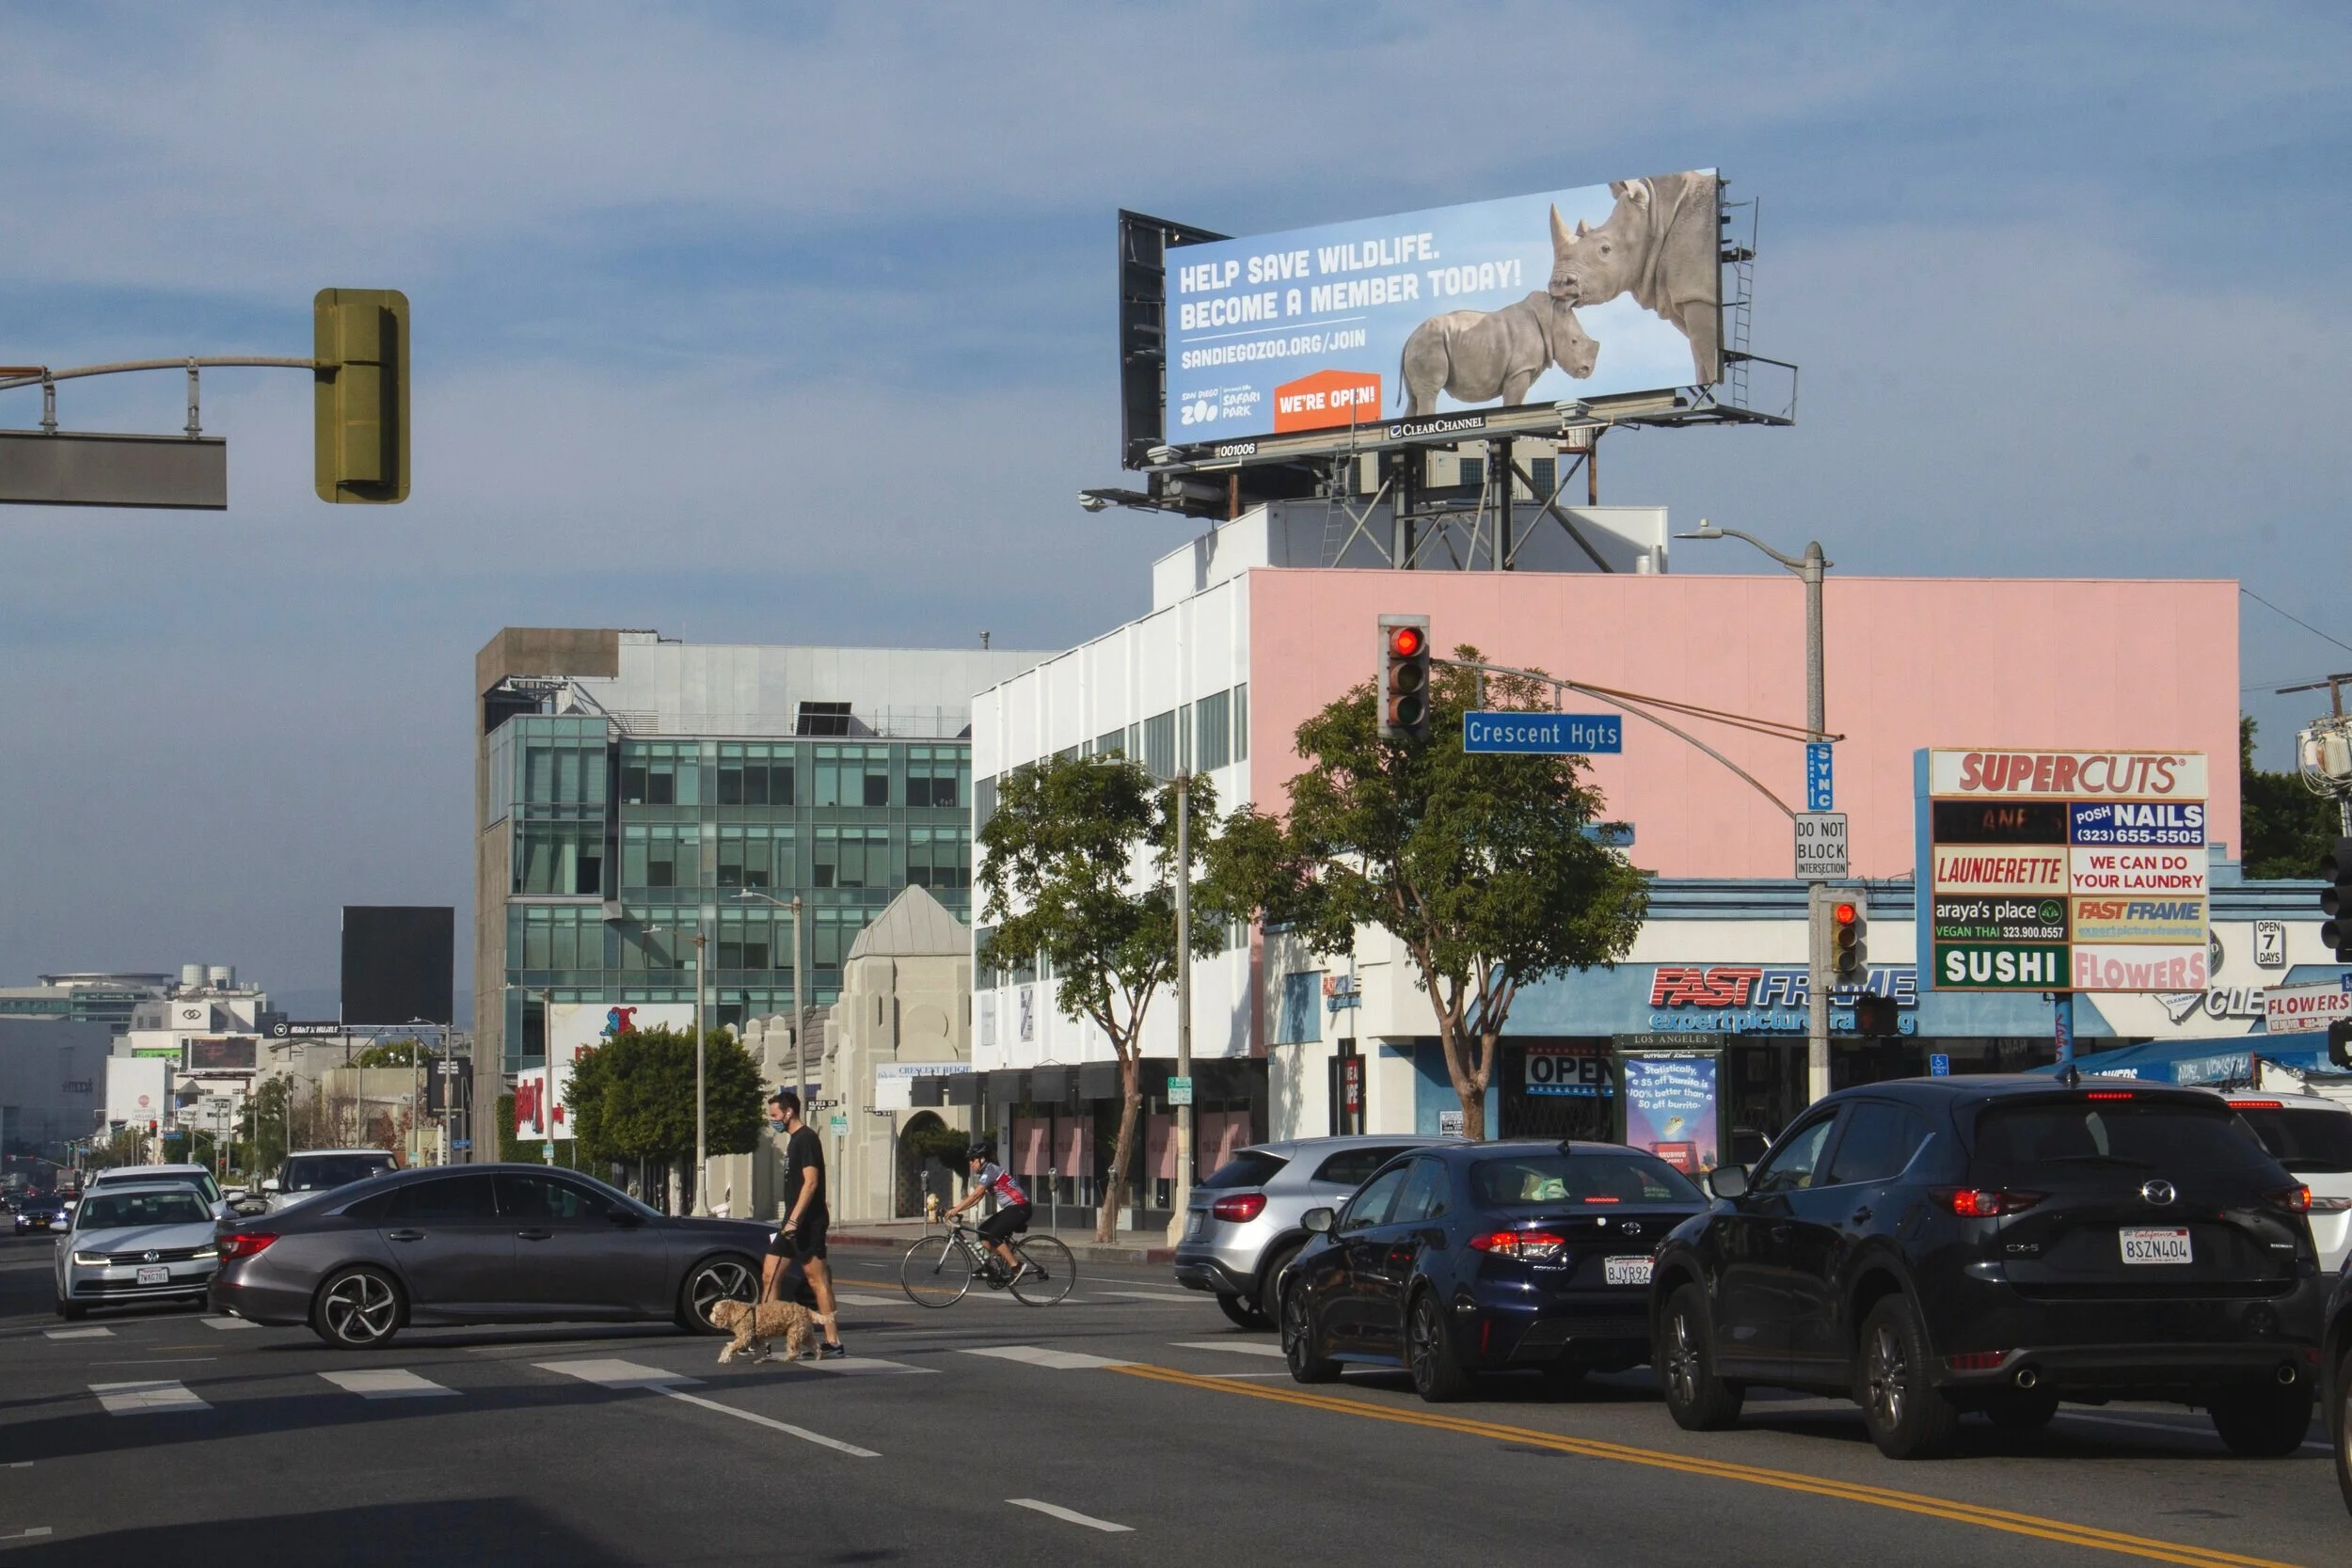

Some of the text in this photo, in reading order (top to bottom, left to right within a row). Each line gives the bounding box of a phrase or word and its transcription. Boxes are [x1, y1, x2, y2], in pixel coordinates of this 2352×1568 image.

[1180, 232, 1439, 293] HELP SAVE WILDLIFE.
[1181, 259, 1521, 330] BECOME A MEMBER TODAY!
[1182, 328, 1365, 369] SANDIEGOZOO.ORG/JOIN
[1182, 390, 1197, 401] SAN
[1198, 388, 1219, 399] DIEGO
[1223, 391, 1261, 405] SAFARI
[1279, 386, 1375, 414] WE'RE OPEN!
[1223, 405, 1252, 419] PARK
[1220, 443, 1255, 457] 001006
[1470, 721, 1617, 750] Crescent Hgts
[1818, 747, 1831, 806] SYNC
[1959, 752, 2178, 794] SUPERCUTS
[2075, 804, 2203, 828] POSH NAILS
[1798, 822, 1844, 836] DO NOT
[2077, 829, 2202, 843] (323) 655-5505
[1798, 844, 1845, 858] BLOCK
[1798, 863, 1845, 874] INTERSECTION
[2090, 856, 2187, 869] WE CAN DO
[1937, 857, 2062, 883] LAUNDERETTE
[2073, 874, 2203, 888] YOUR LAUNDRY
[1936, 900, 2036, 922] araya's place
[1936, 926, 2064, 939] VEGAN THAI 323.900.0557
[2258, 922, 2280, 933] OPEN
[2263, 934, 2275, 950] 7
[2260, 952, 2280, 963] DAYS
[1946, 950, 2056, 982] SUSHI
[2074, 952, 2206, 989] FLOWERS
[2167, 994, 2197, 1005] CLEANERS
[2204, 988, 2265, 1016] CLE
[2268, 993, 2349, 1015] FLOWERS
[1659, 1035, 1708, 1043] ANGELES
[1645, 1065, 1697, 1075] Statistically,
[1641, 1078, 1653, 1086] $5
[1655, 1074, 1667, 1085] off
[1669, 1075, 1699, 1088] burrito
[1701, 1079, 1708, 1088] is
[1629, 1088, 1653, 1099] 100%
[1655, 1088, 1681, 1098] better
[1684, 1088, 1704, 1099] than
[1638, 1100, 1650, 1108] $0
[1653, 1100, 1665, 1109] off
[2006, 1243, 2040, 1252] CX-5
[2126, 1241, 2186, 1258] 8SZN404
[1608, 1266, 1649, 1279] 8JYR92
